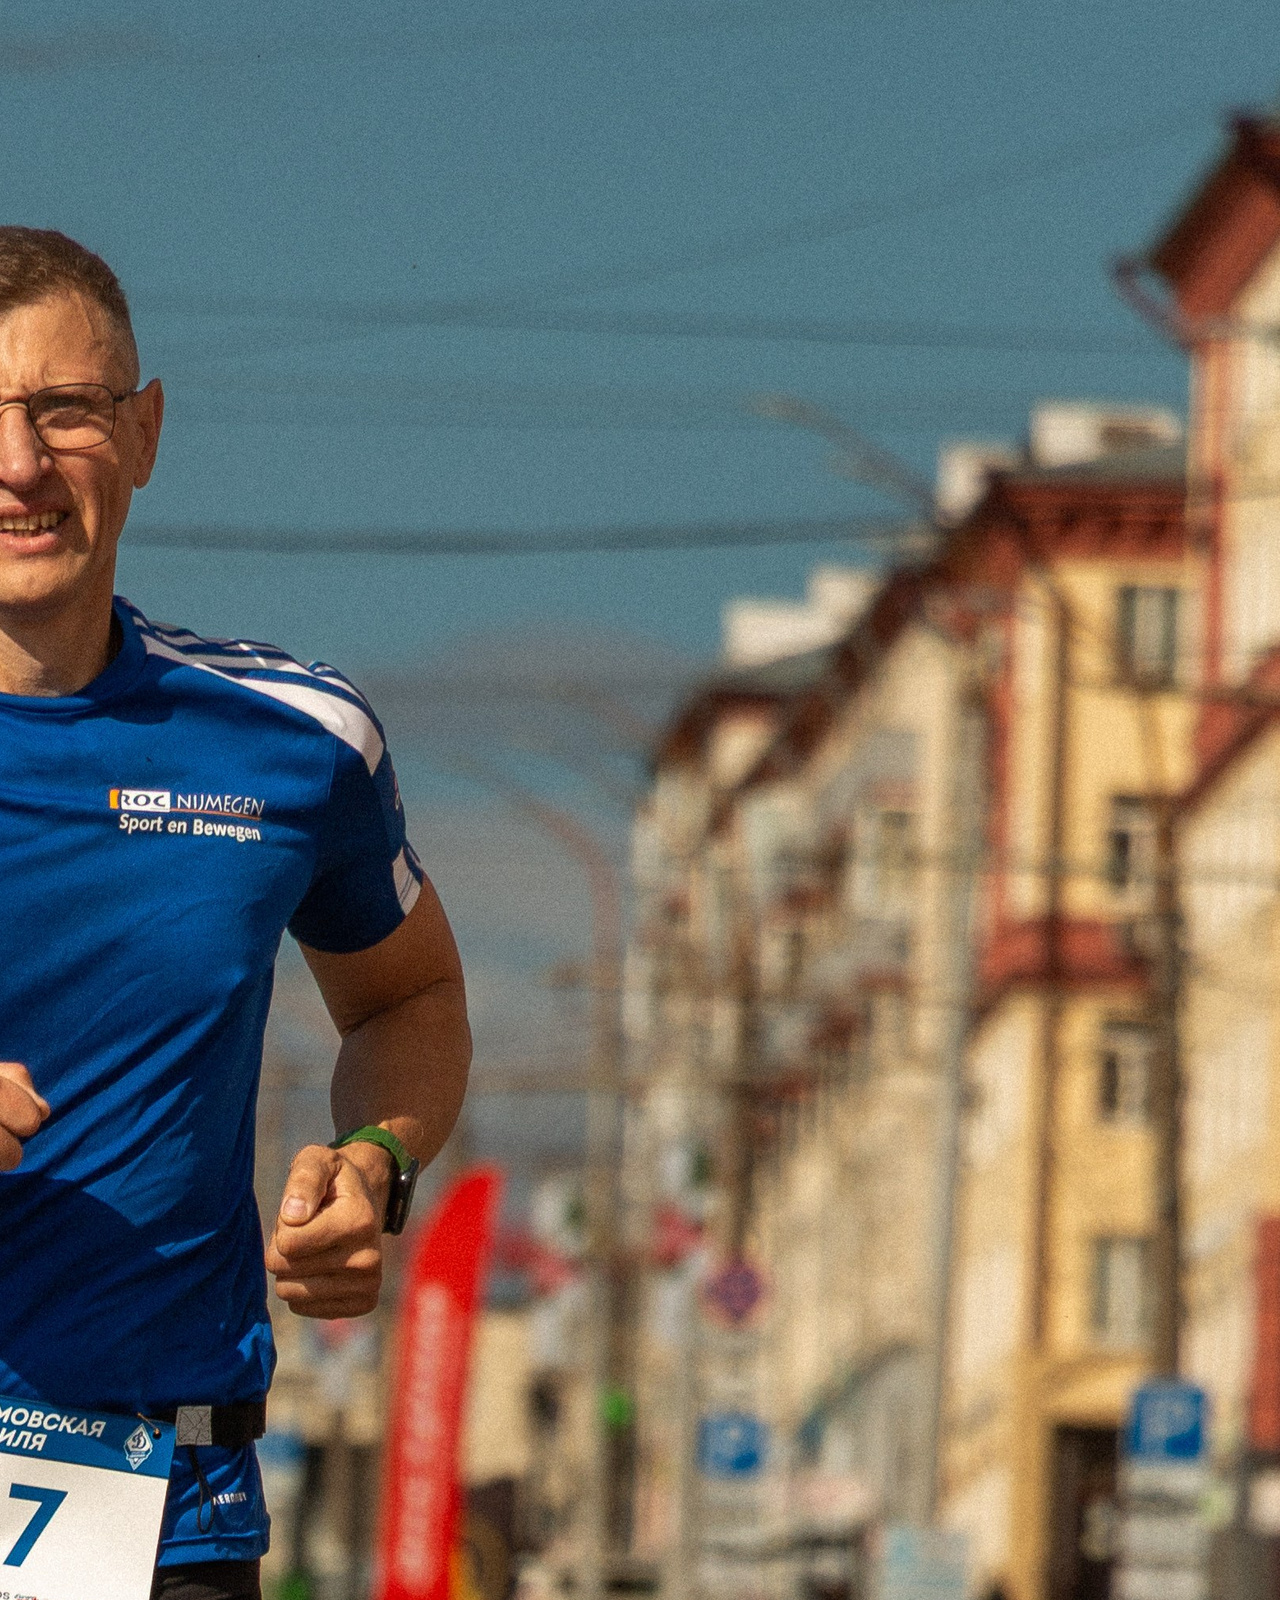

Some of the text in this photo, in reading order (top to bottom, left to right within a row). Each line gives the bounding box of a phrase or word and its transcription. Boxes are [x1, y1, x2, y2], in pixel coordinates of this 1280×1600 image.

[122, 794, 265, 815] ROC NIJMEGEN
[120, 813, 261, 843] Sport en Bewegen
